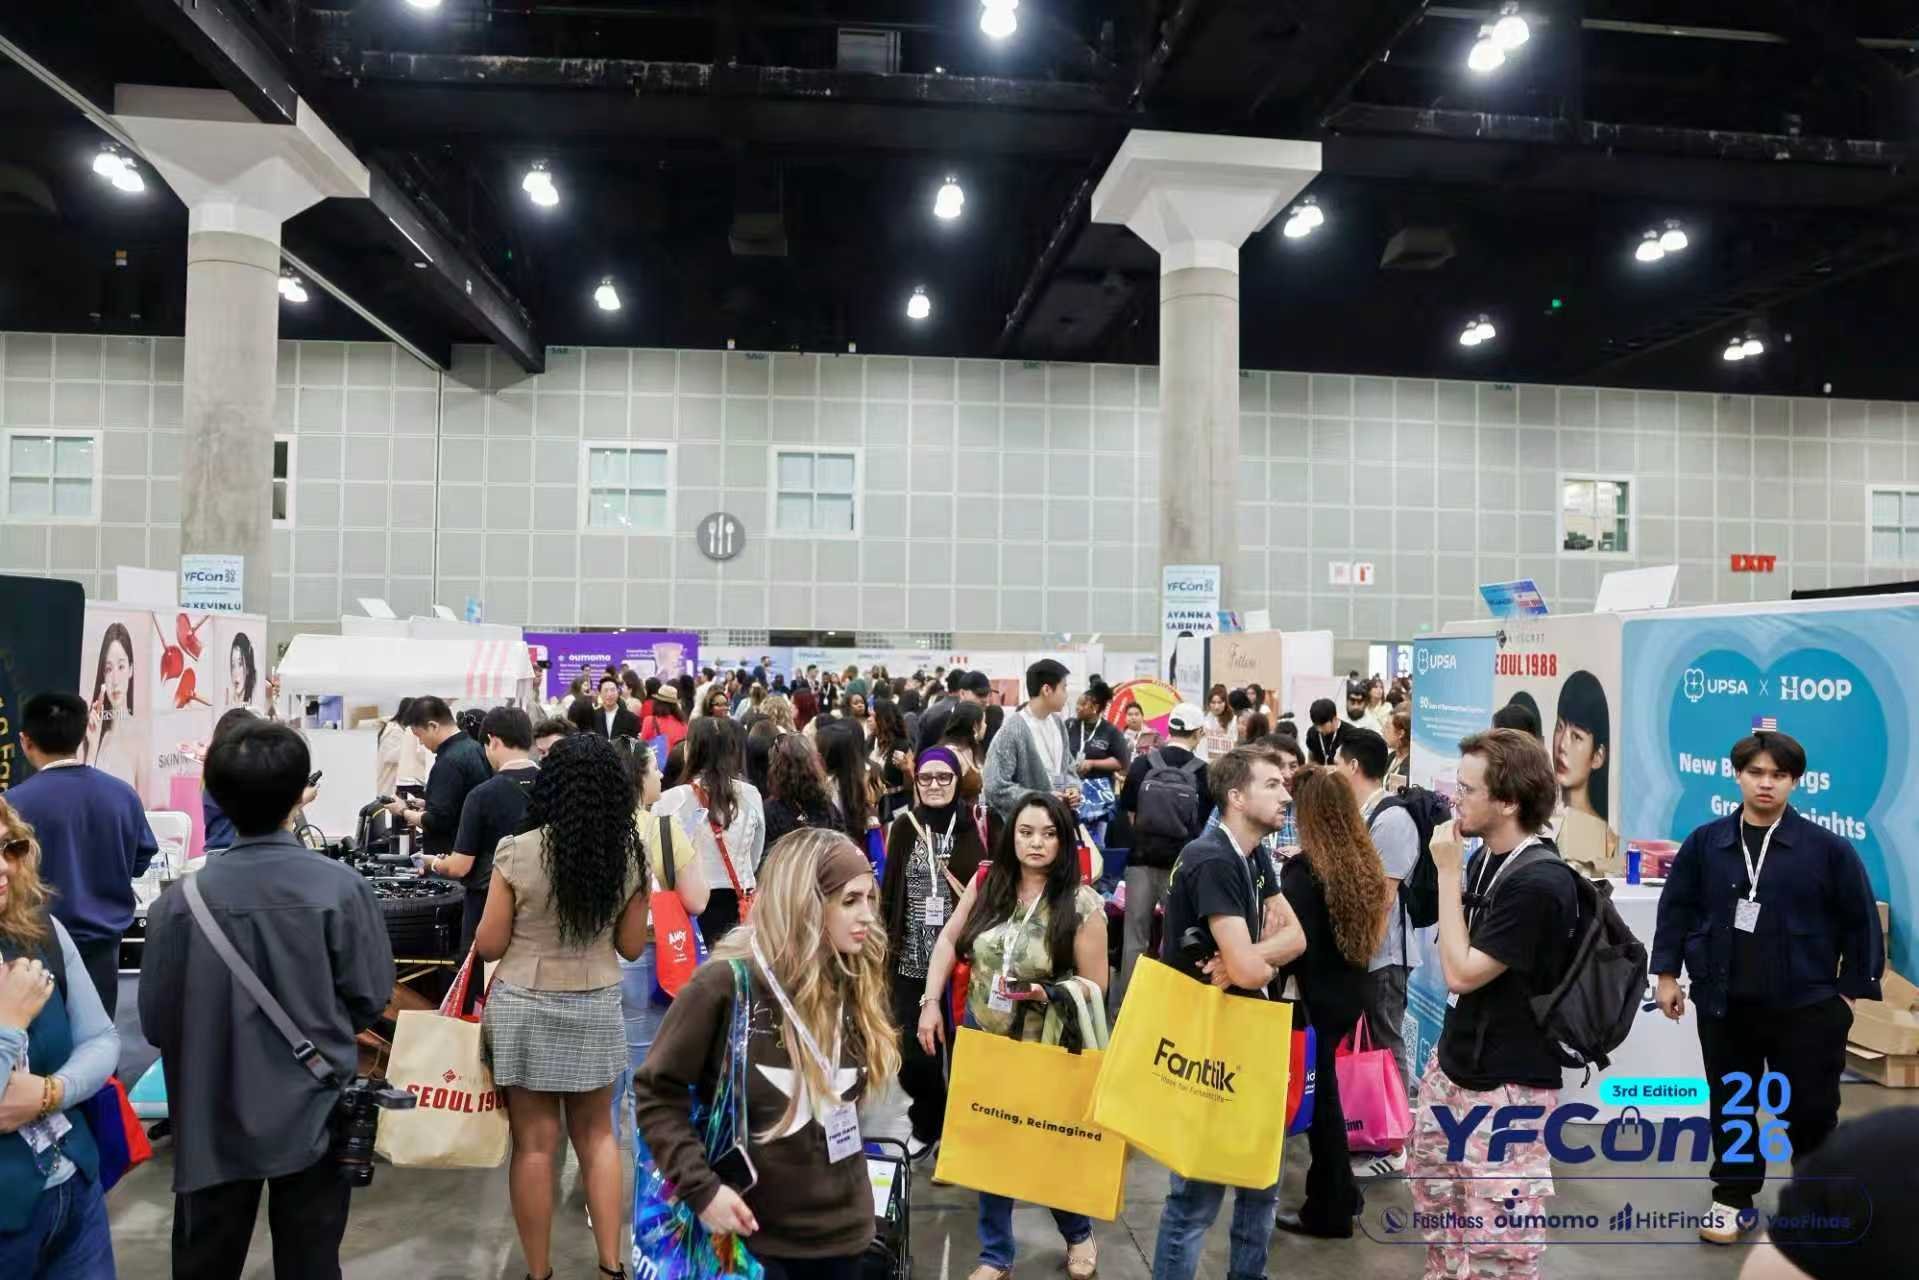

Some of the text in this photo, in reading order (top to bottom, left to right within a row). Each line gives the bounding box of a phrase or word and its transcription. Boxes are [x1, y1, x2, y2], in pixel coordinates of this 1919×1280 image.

[1730, 554, 1777, 572] EXIT
[184, 571, 224, 582] YFCon
[1167, 581, 1204, 591] YFCon
[1167, 611, 1212, 619] AYANNA
[568, 654, 611, 662] oumomo
[1429, 654, 1457, 670] UPSA
[1526, 653, 1557, 677] 1988
[1706, 679, 1749, 695] UPSA
[1779, 675, 1853, 701] HOOP
[158, 750, 180, 769] SKIN
[1679, 752, 1717, 775] New
[1153, 1036, 1237, 1094] Fanttik
[970, 1101, 1103, 1142] Crafting, Reimagined
